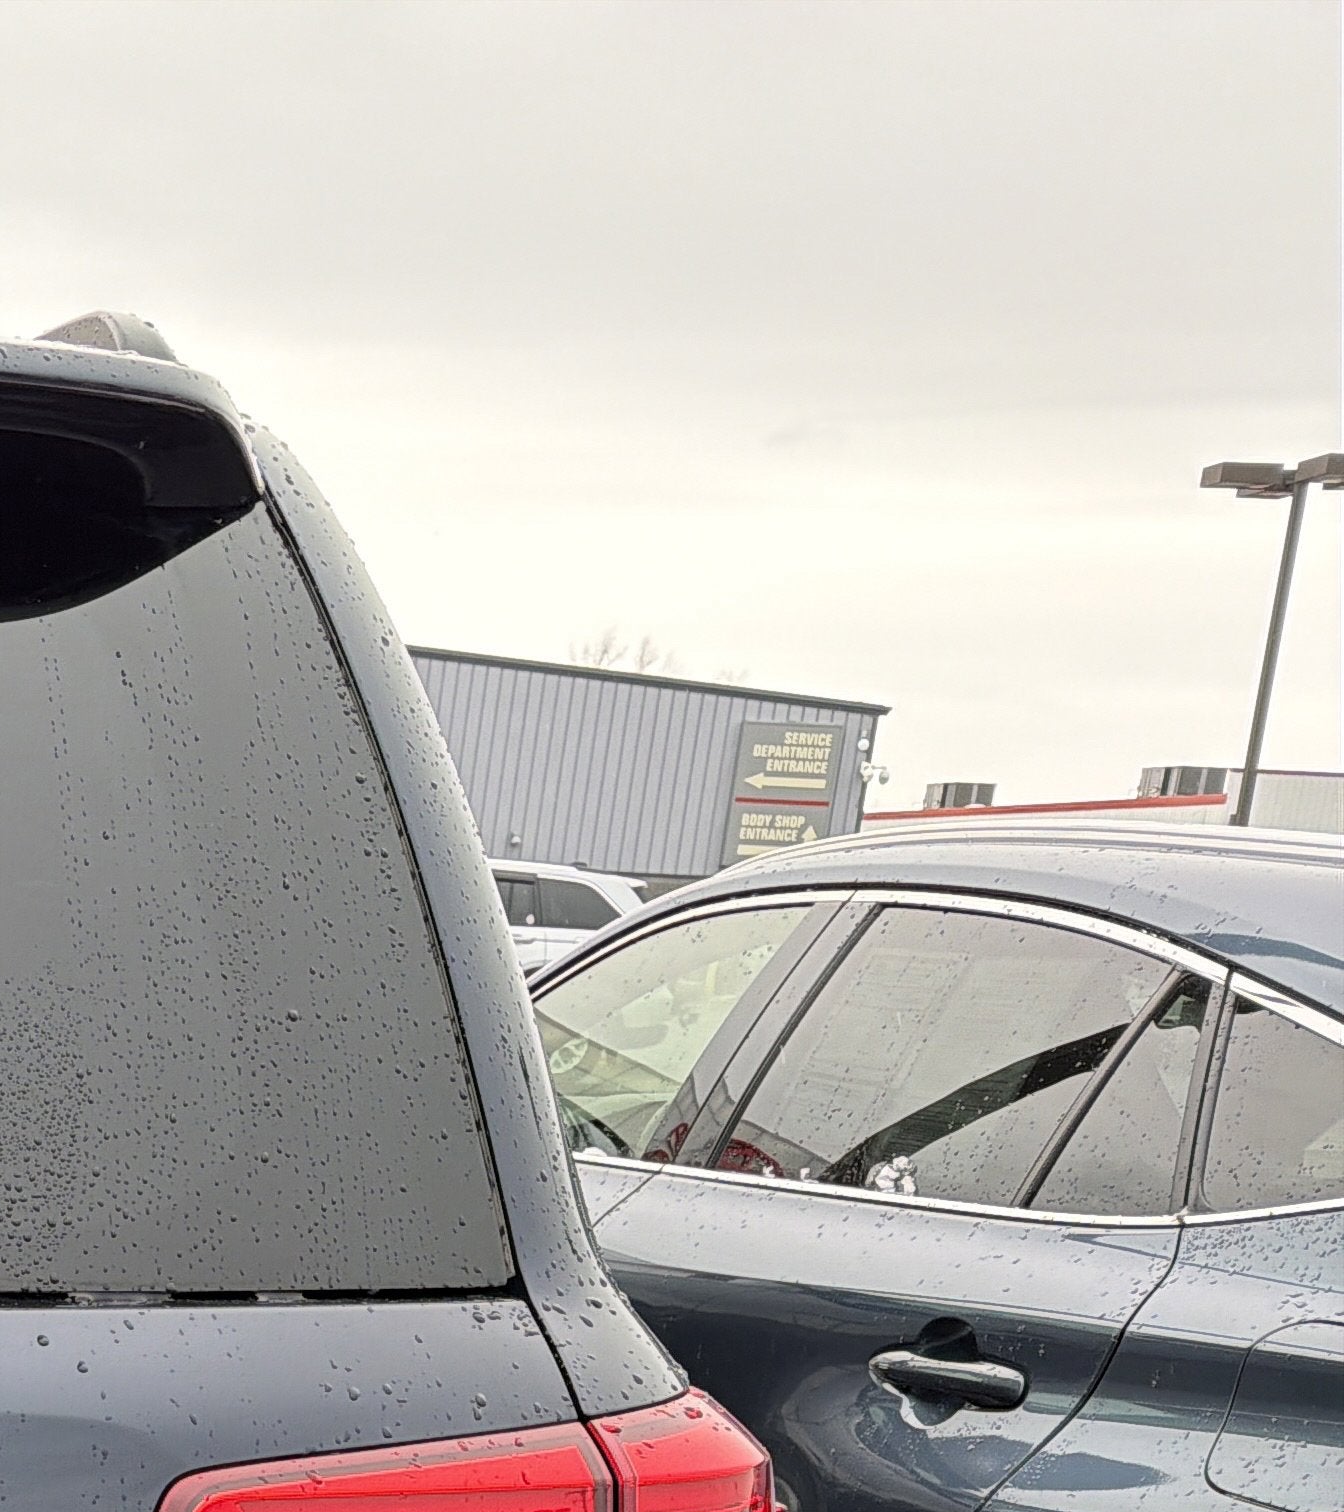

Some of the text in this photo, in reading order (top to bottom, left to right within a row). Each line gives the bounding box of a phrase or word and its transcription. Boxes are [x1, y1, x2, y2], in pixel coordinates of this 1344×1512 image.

[784, 731, 833, 747] SERVICE
[753, 744, 831, 760] DEPARTMENT
[766, 759, 828, 774] ENTRANCE
[741, 813, 805, 828] BODY SHOP
[739, 826, 799, 842] ENTRANCE
